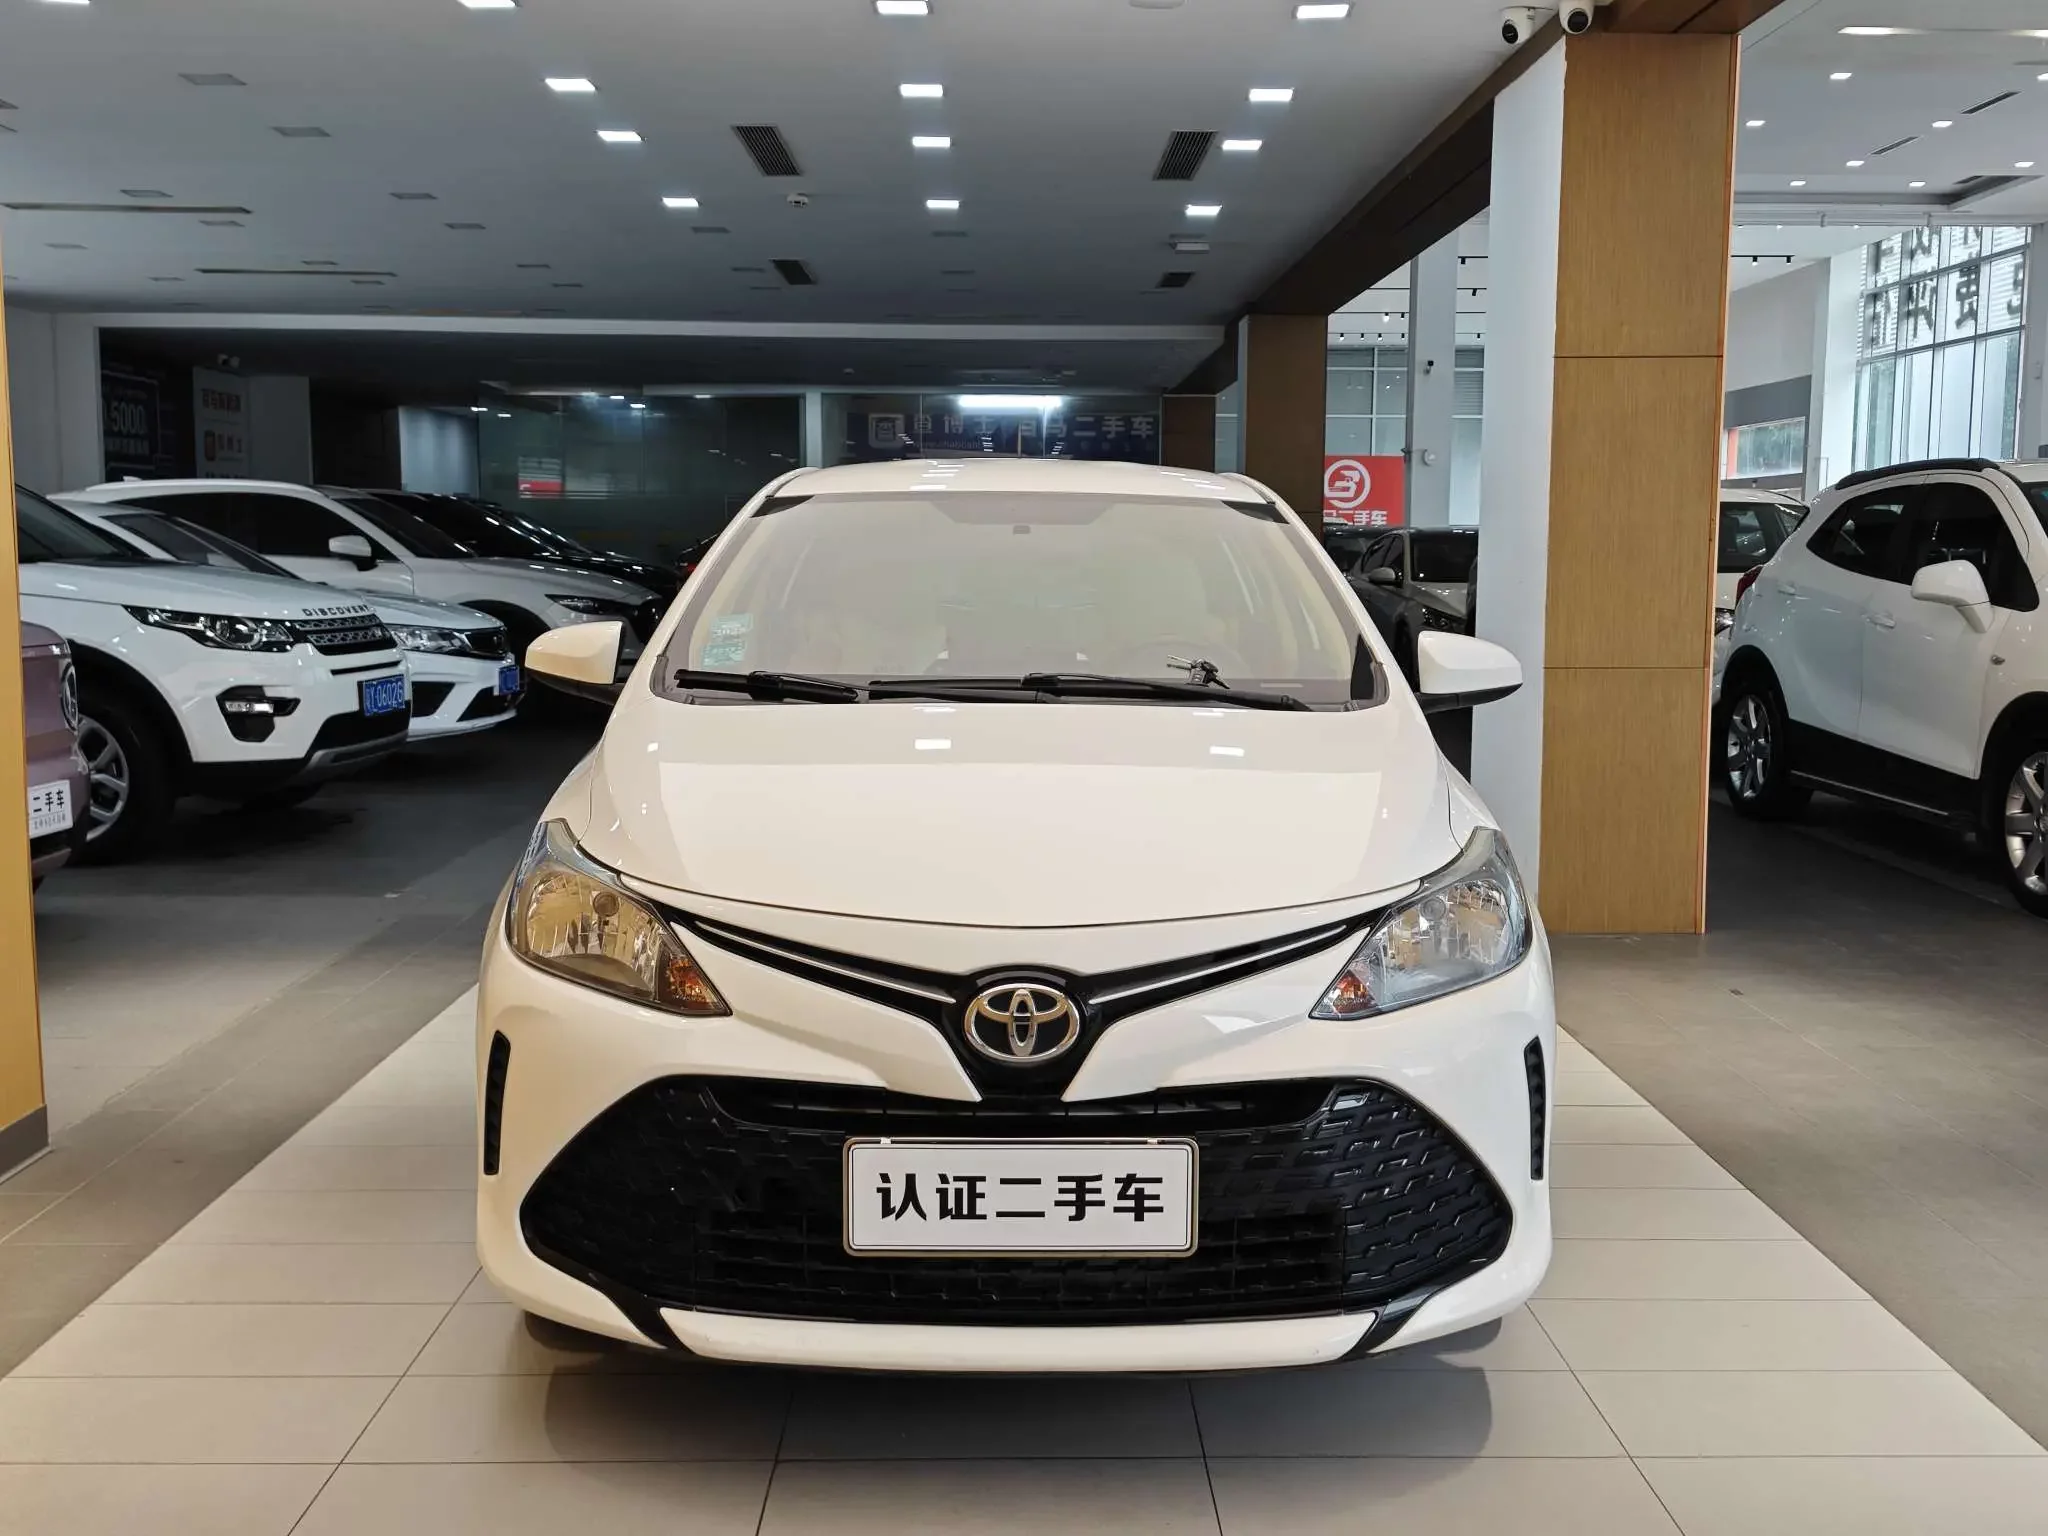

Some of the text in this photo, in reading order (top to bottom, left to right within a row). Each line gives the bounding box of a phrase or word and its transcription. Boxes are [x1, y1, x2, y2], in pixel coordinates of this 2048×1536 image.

[876, 1173, 1164, 1222] 认证二手车
